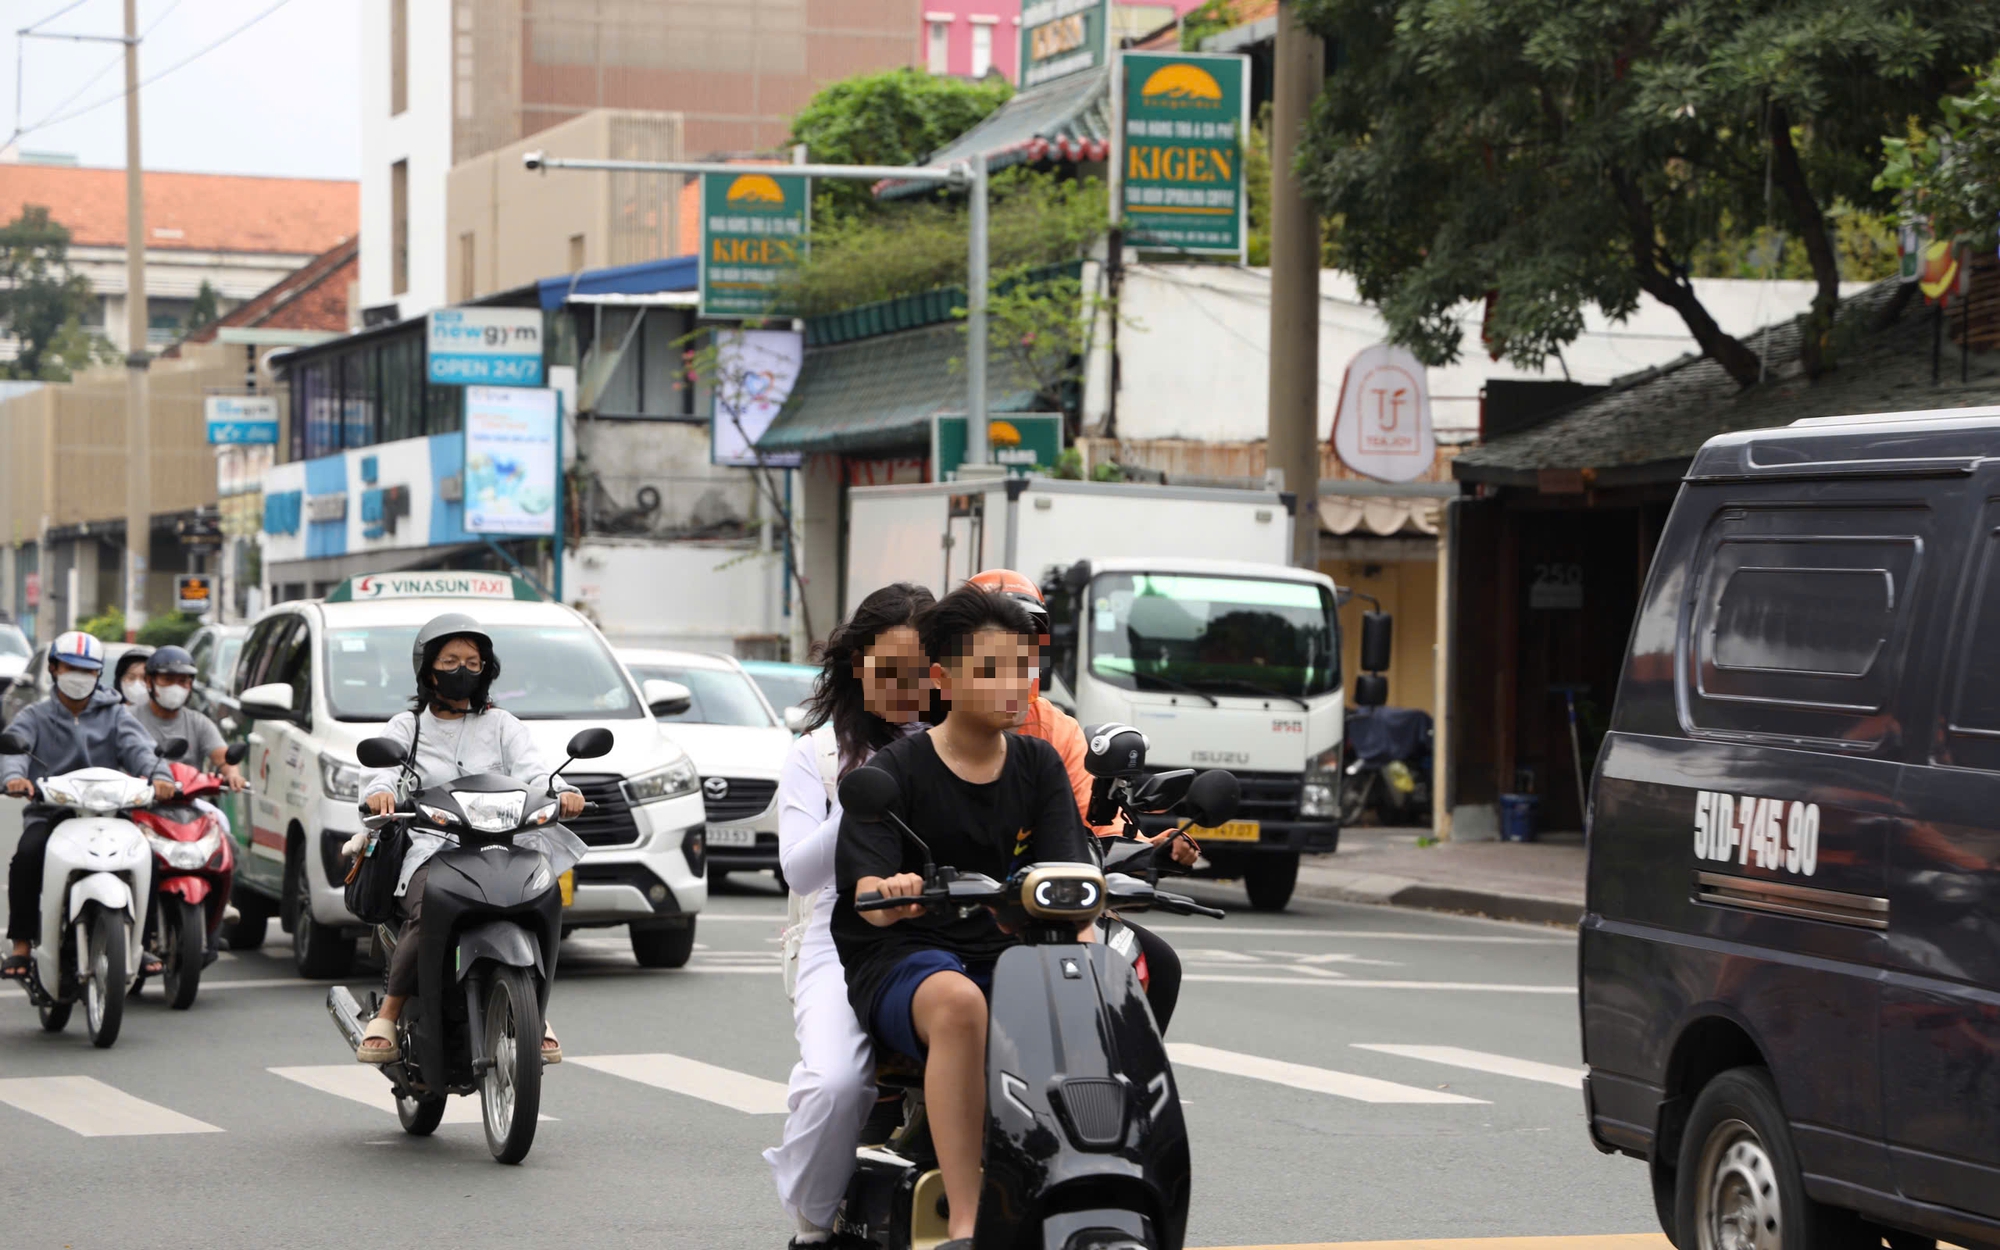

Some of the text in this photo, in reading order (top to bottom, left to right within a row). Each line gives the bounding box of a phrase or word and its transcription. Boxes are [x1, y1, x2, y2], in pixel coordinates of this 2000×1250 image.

[1129, 146, 1234, 181] KIGEN
[713, 238, 798, 264] KIGEN
[433, 325, 537, 346] newgym
[432, 359, 538, 380] OPEN 24/7
[1533, 563, 1583, 587] 250
[1191, 751, 1250, 764] ISUZU
[480, 844, 509, 852] HONDA
